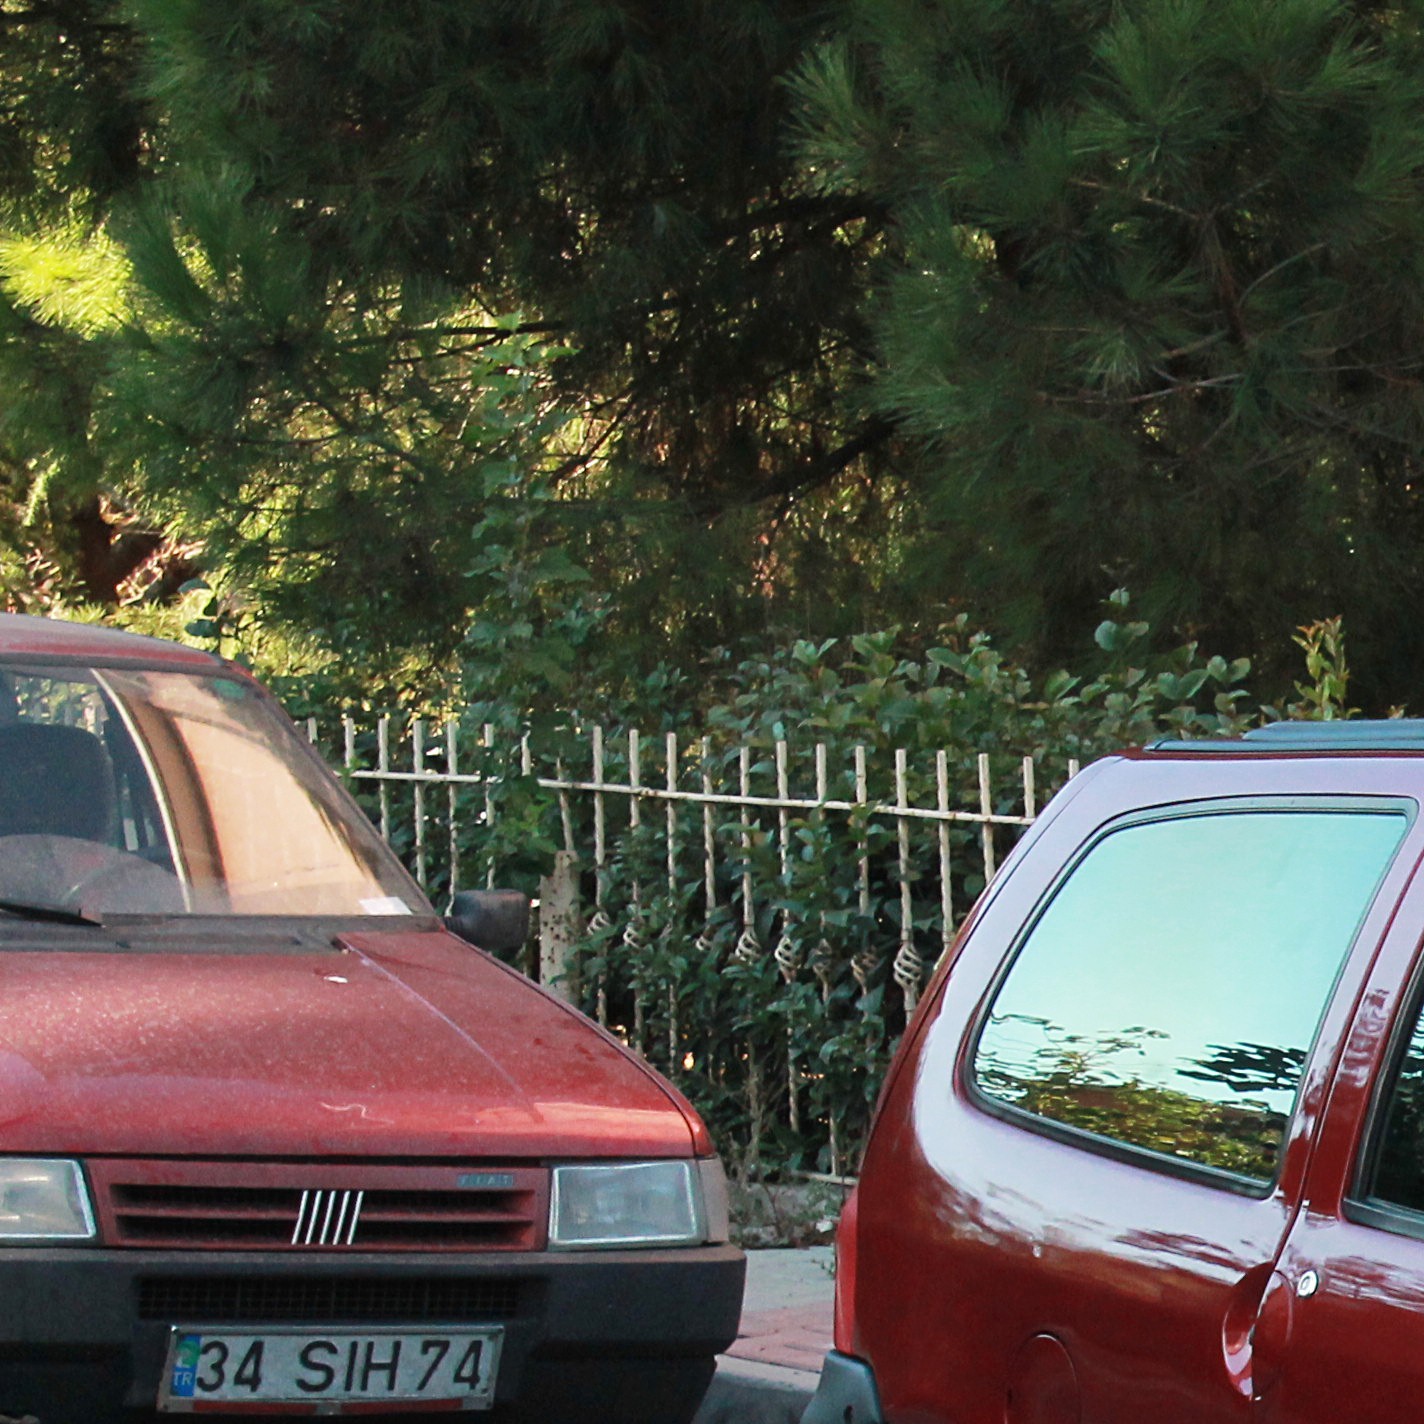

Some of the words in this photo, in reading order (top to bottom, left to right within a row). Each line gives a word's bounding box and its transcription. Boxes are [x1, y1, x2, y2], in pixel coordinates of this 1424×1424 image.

[172, 1371, 192, 1386] TR
[195, 1340, 265, 1392] 34
[295, 1340, 402, 1392] SIH
[416, 1339, 483, 1390] 74
